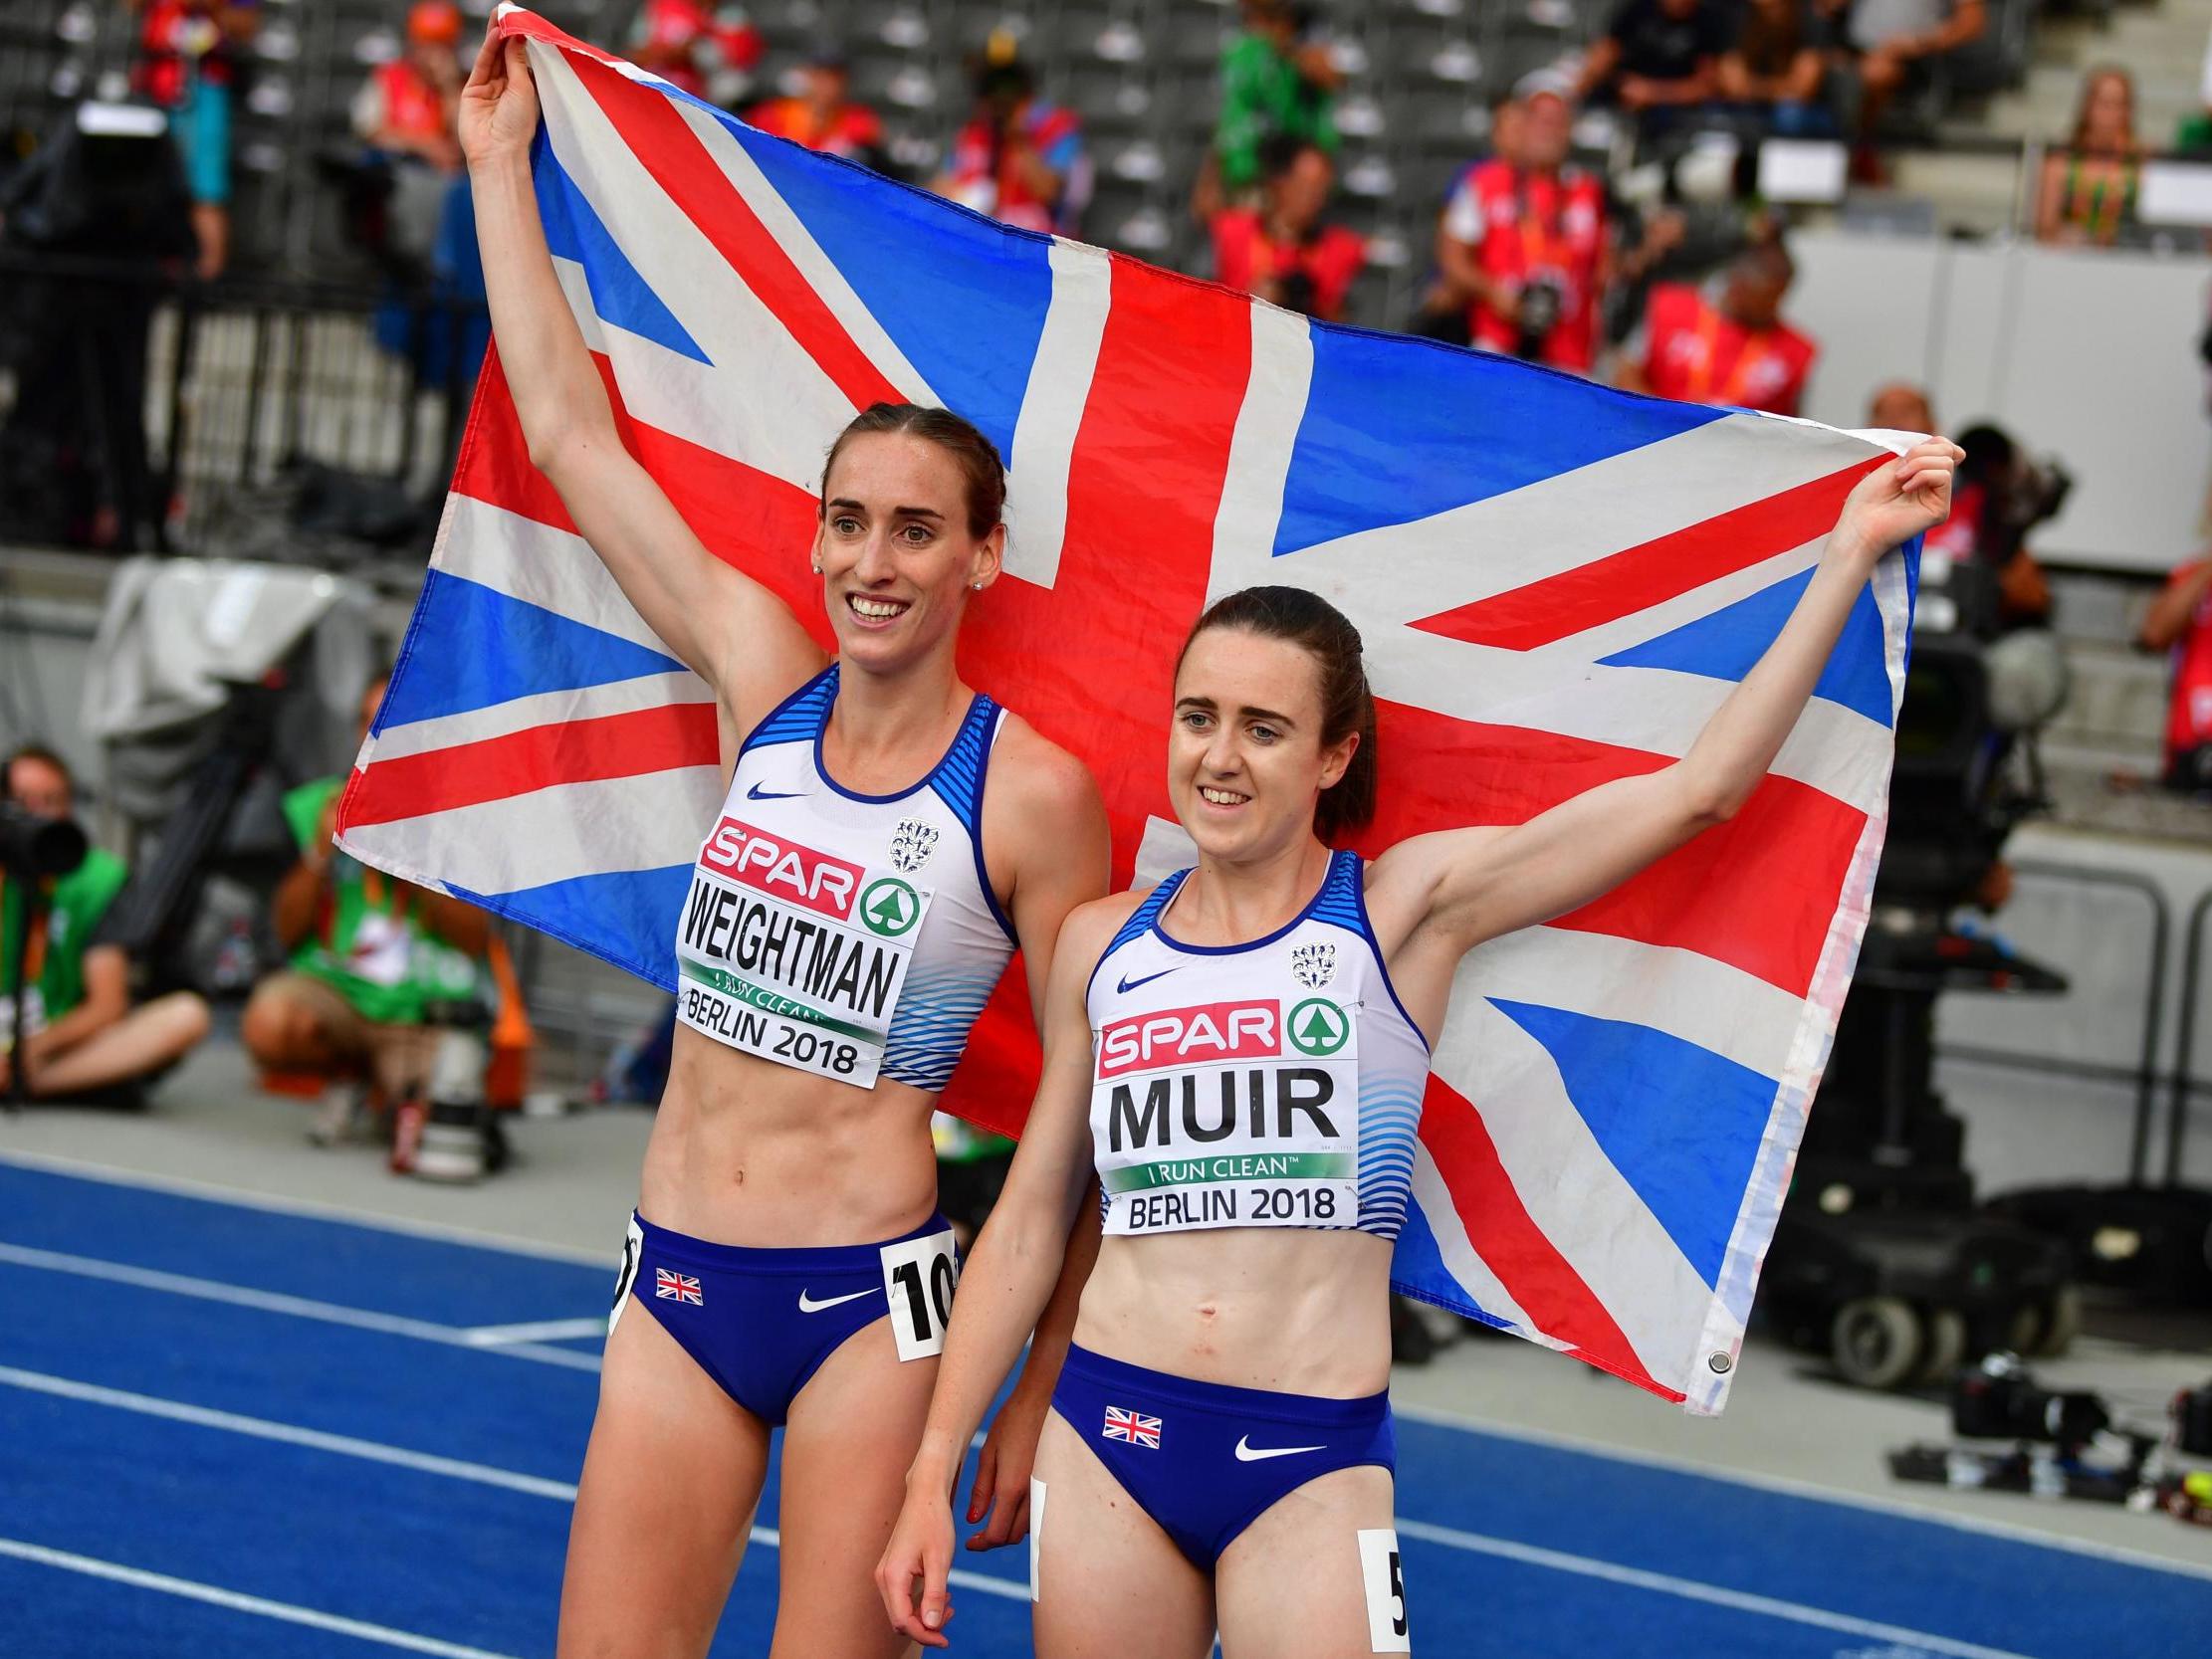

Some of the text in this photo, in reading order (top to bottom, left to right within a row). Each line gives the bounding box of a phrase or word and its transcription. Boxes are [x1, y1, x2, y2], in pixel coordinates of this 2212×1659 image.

[707, 825, 855, 911] SPAR
[684, 878, 900, 1019] WEIGHTMAN
[723, 975, 757, 999] RUN
[687, 988, 859, 1075] BERLIN 2018
[1103, 1007, 1275, 1069] SPAR
[1108, 1067, 1341, 1153] MUIR
[1128, 1187, 1336, 1230] BERLIN 2018
[1148, 1167, 1156, 1184] I
[1160, 1161, 1207, 1182] RUN
[891, 1251, 955, 1343] 10
